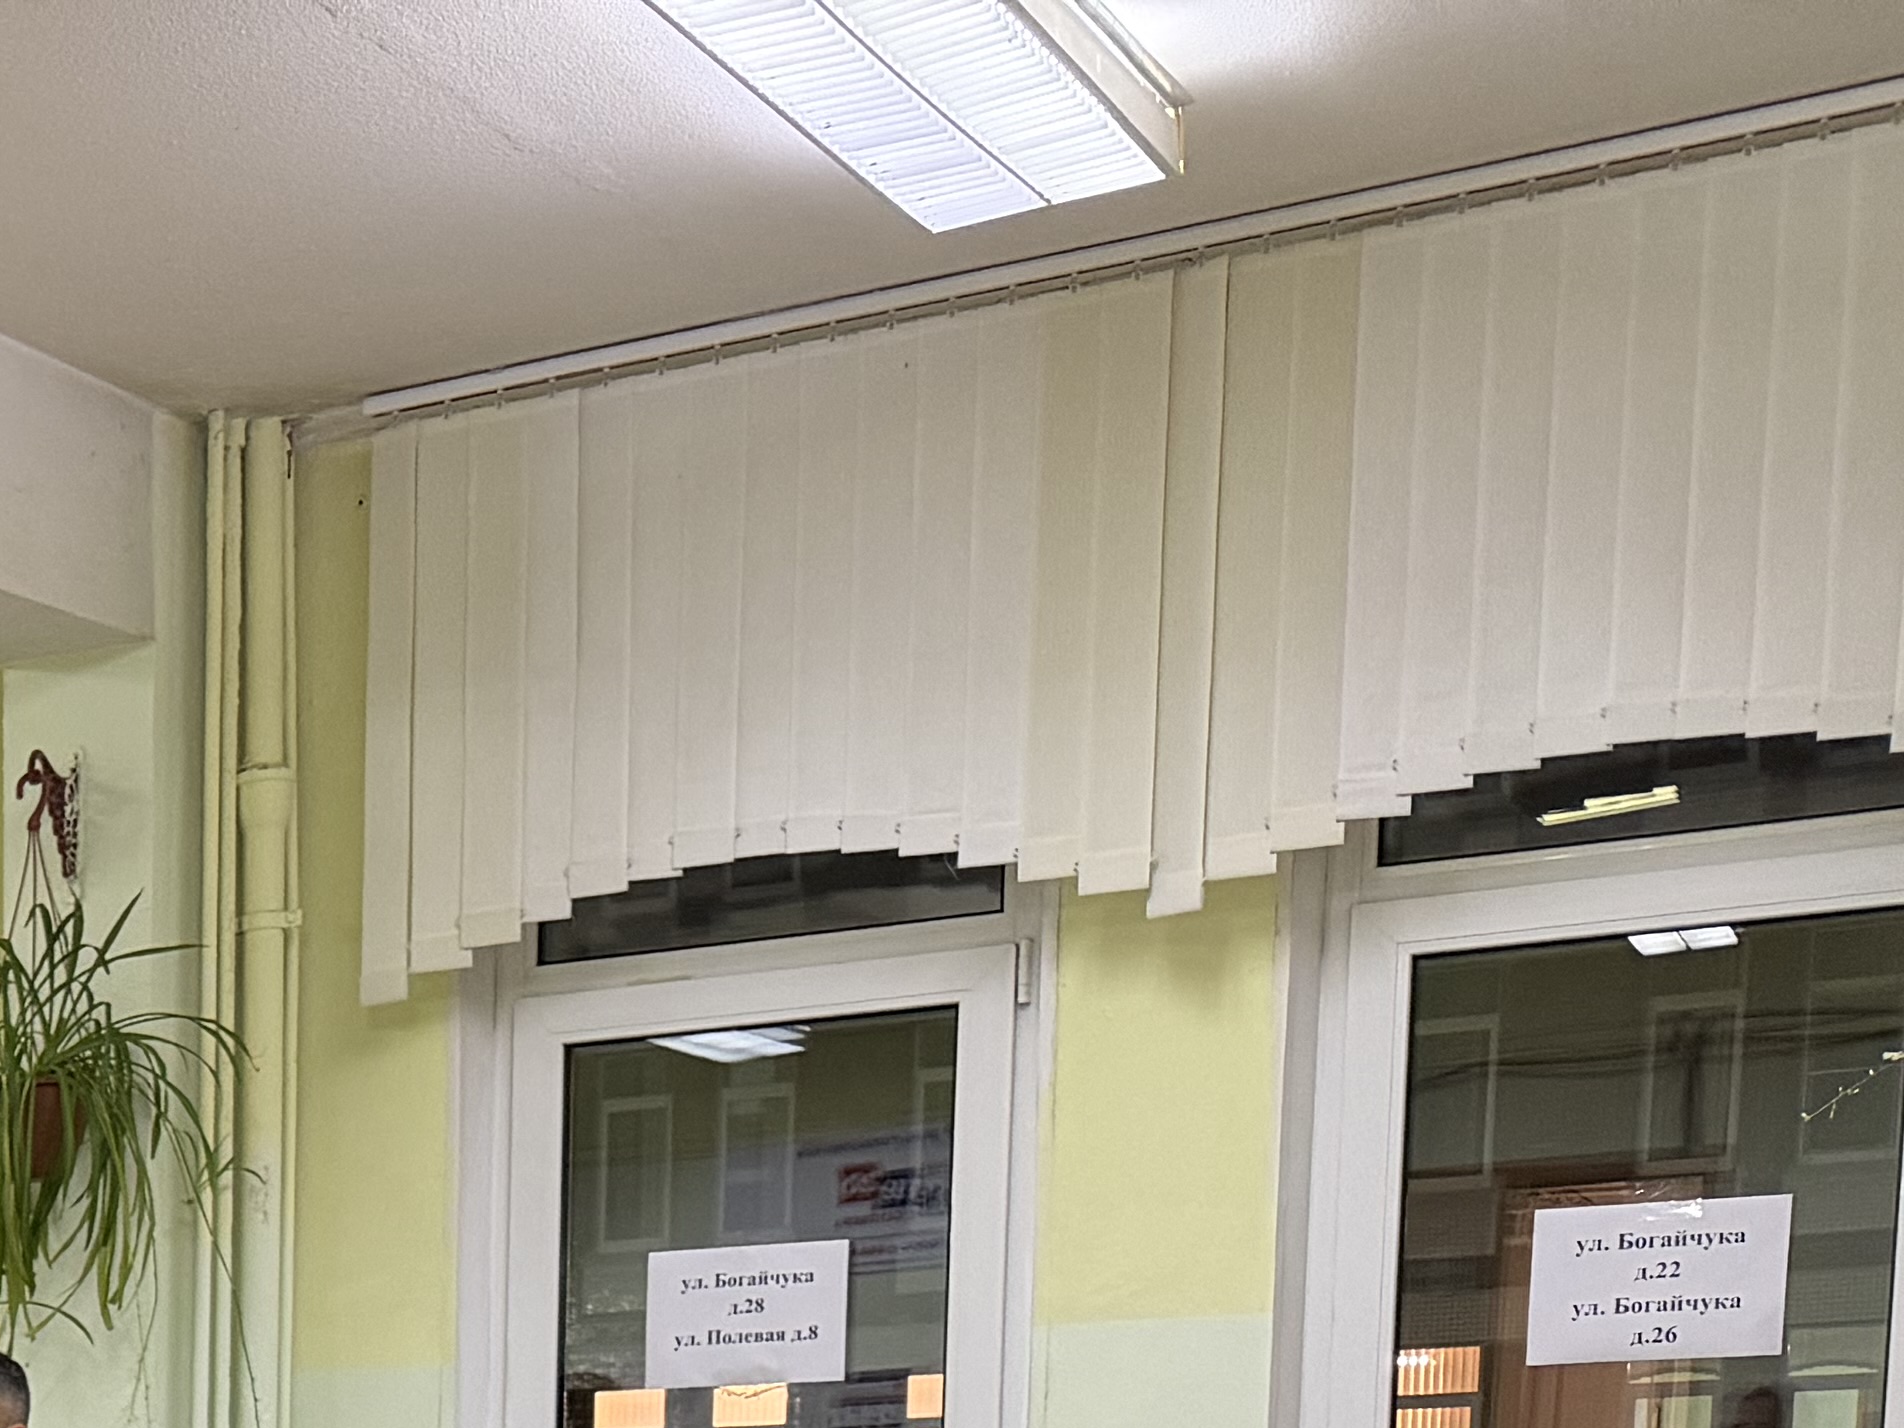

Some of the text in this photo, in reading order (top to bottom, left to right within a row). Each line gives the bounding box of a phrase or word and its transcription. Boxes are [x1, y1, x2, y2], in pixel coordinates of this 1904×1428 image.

[1575, 1230, 1746, 1257] ул. Богайчука
[681, 1270, 815, 1295] ул. Богайчука
[1633, 1260, 1681, 1281] д.22
[727, 1297, 765, 1317] д.28
[1571, 1293, 1742, 1322] ул. Богайчука
[674, 1324, 819, 1352] ул. Полевая д.8
[1629, 1325, 1678, 1347] д.26
